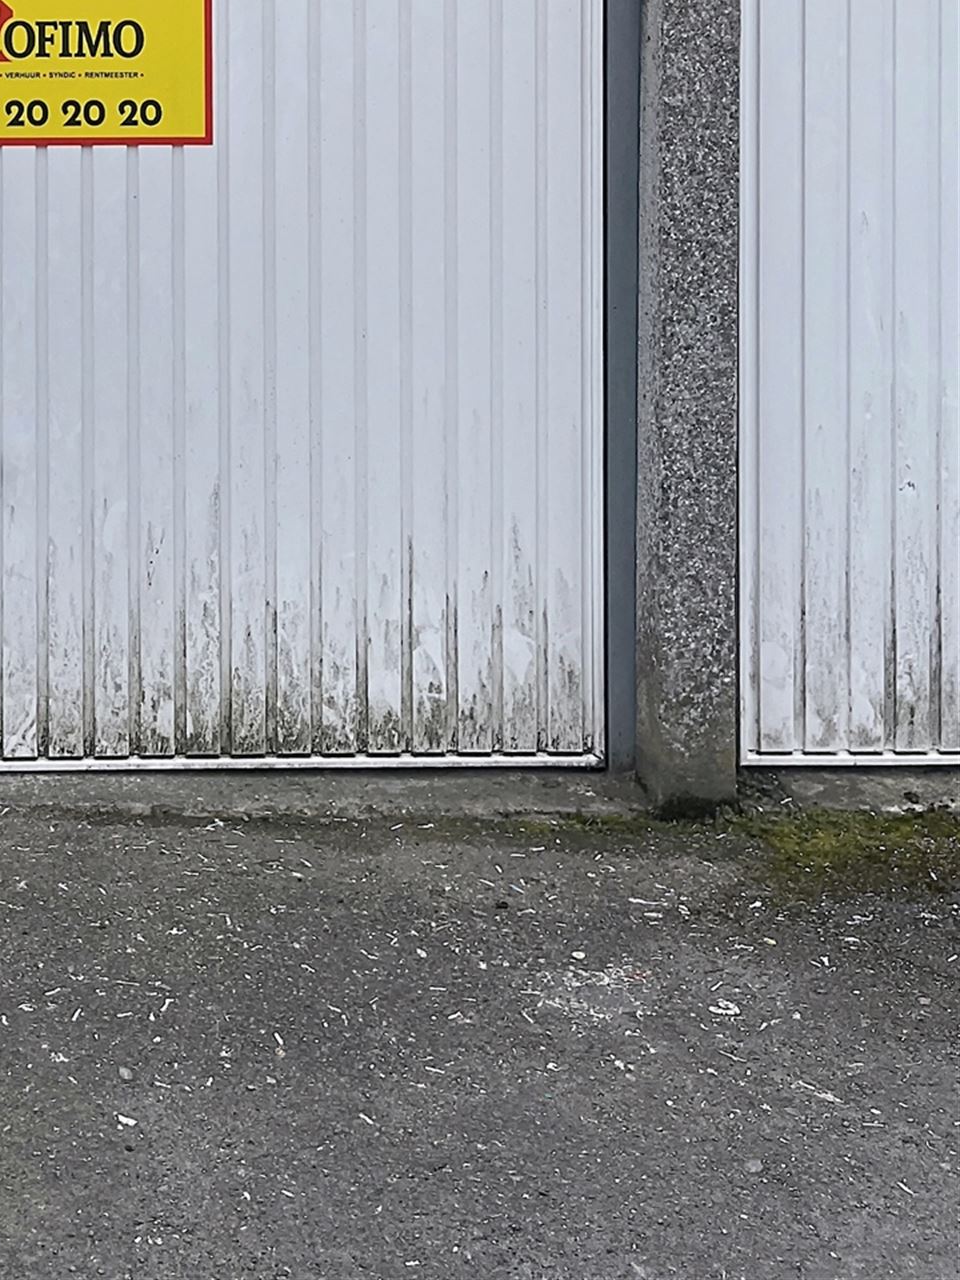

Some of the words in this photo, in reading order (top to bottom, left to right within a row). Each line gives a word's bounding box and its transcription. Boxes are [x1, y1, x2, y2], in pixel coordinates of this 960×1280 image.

[4, 71, 41, 79] VERHUUR
[48, 71, 76, 79] SYNDIC
[84, 71, 139, 79] RENTMEESTER
[4, 99, 49, 127] 20
[61, 99, 106, 127] 20
[118, 99, 163, 127] 20
